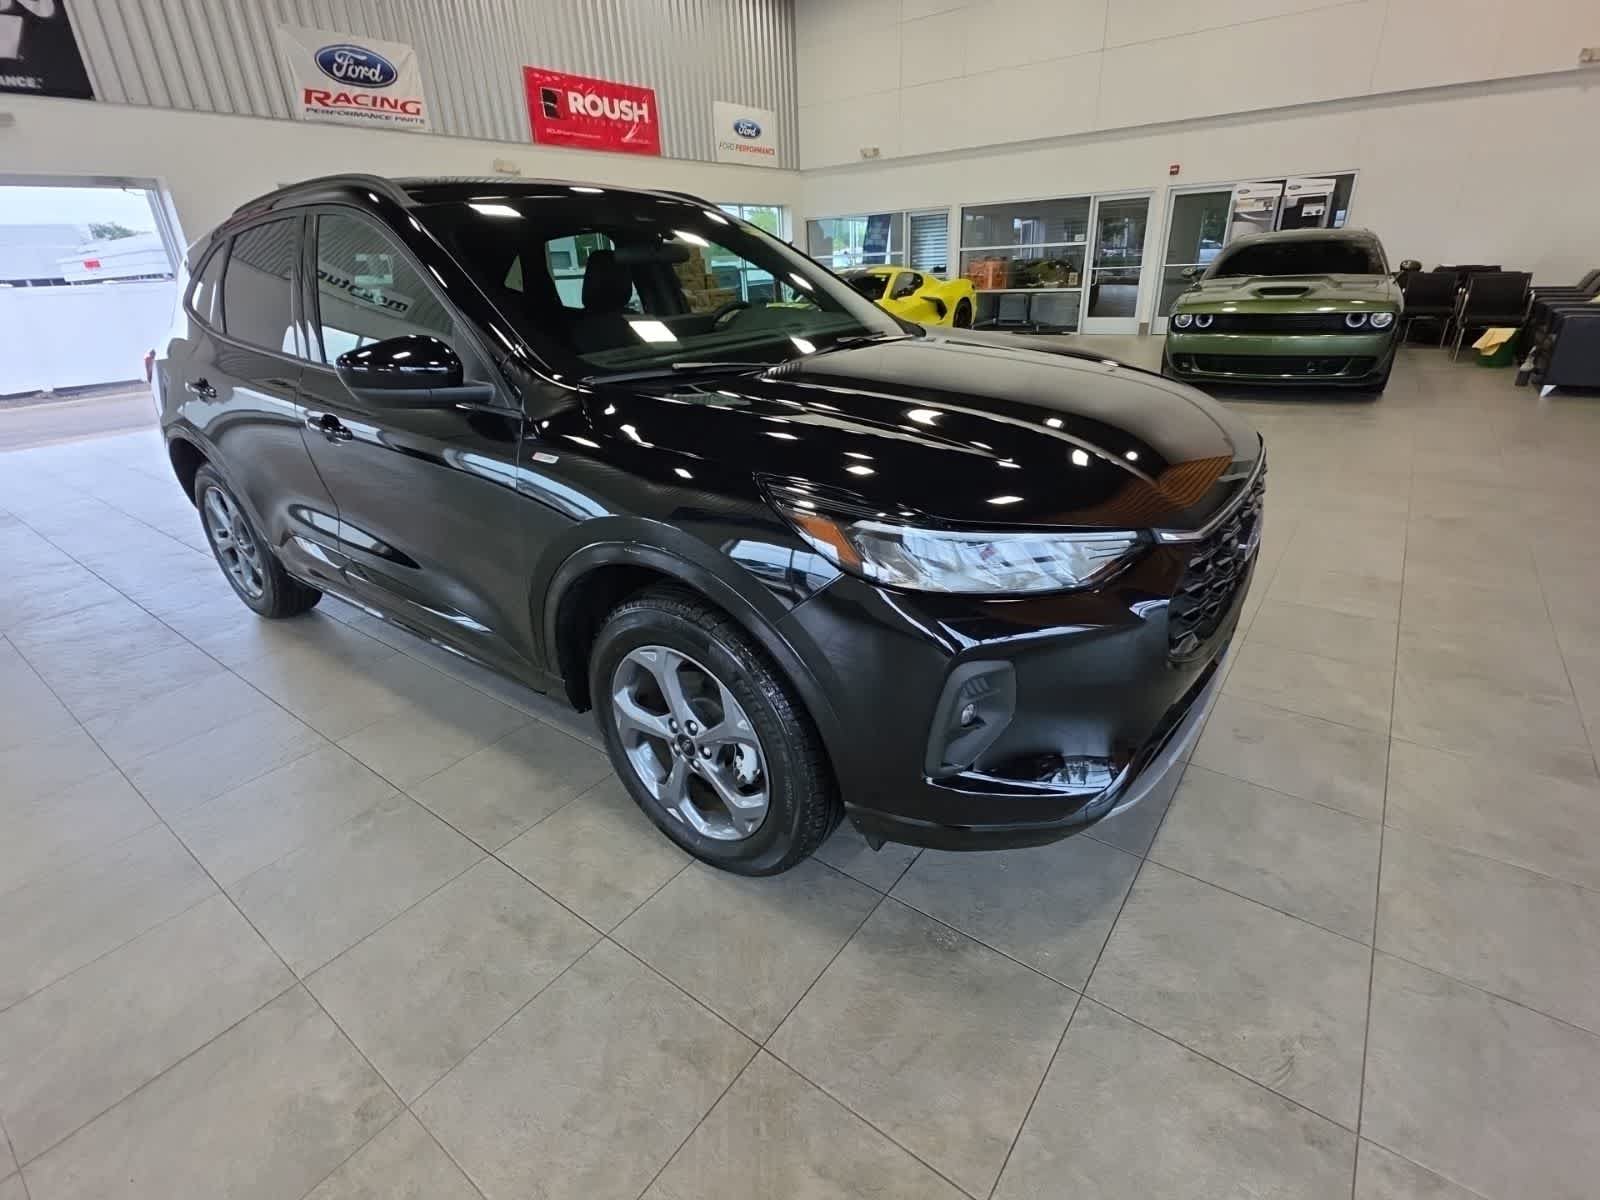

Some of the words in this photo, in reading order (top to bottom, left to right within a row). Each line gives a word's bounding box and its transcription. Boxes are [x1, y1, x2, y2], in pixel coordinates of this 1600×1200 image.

[332, 50, 384, 82] Ford
[304, 88, 422, 116] RACING
[306, 107, 391, 120] PERFORMANCE
[395, 115, 425, 125] PARTS
[567, 91, 649, 124] ROUSH
[738, 122, 757, 137] Ford
